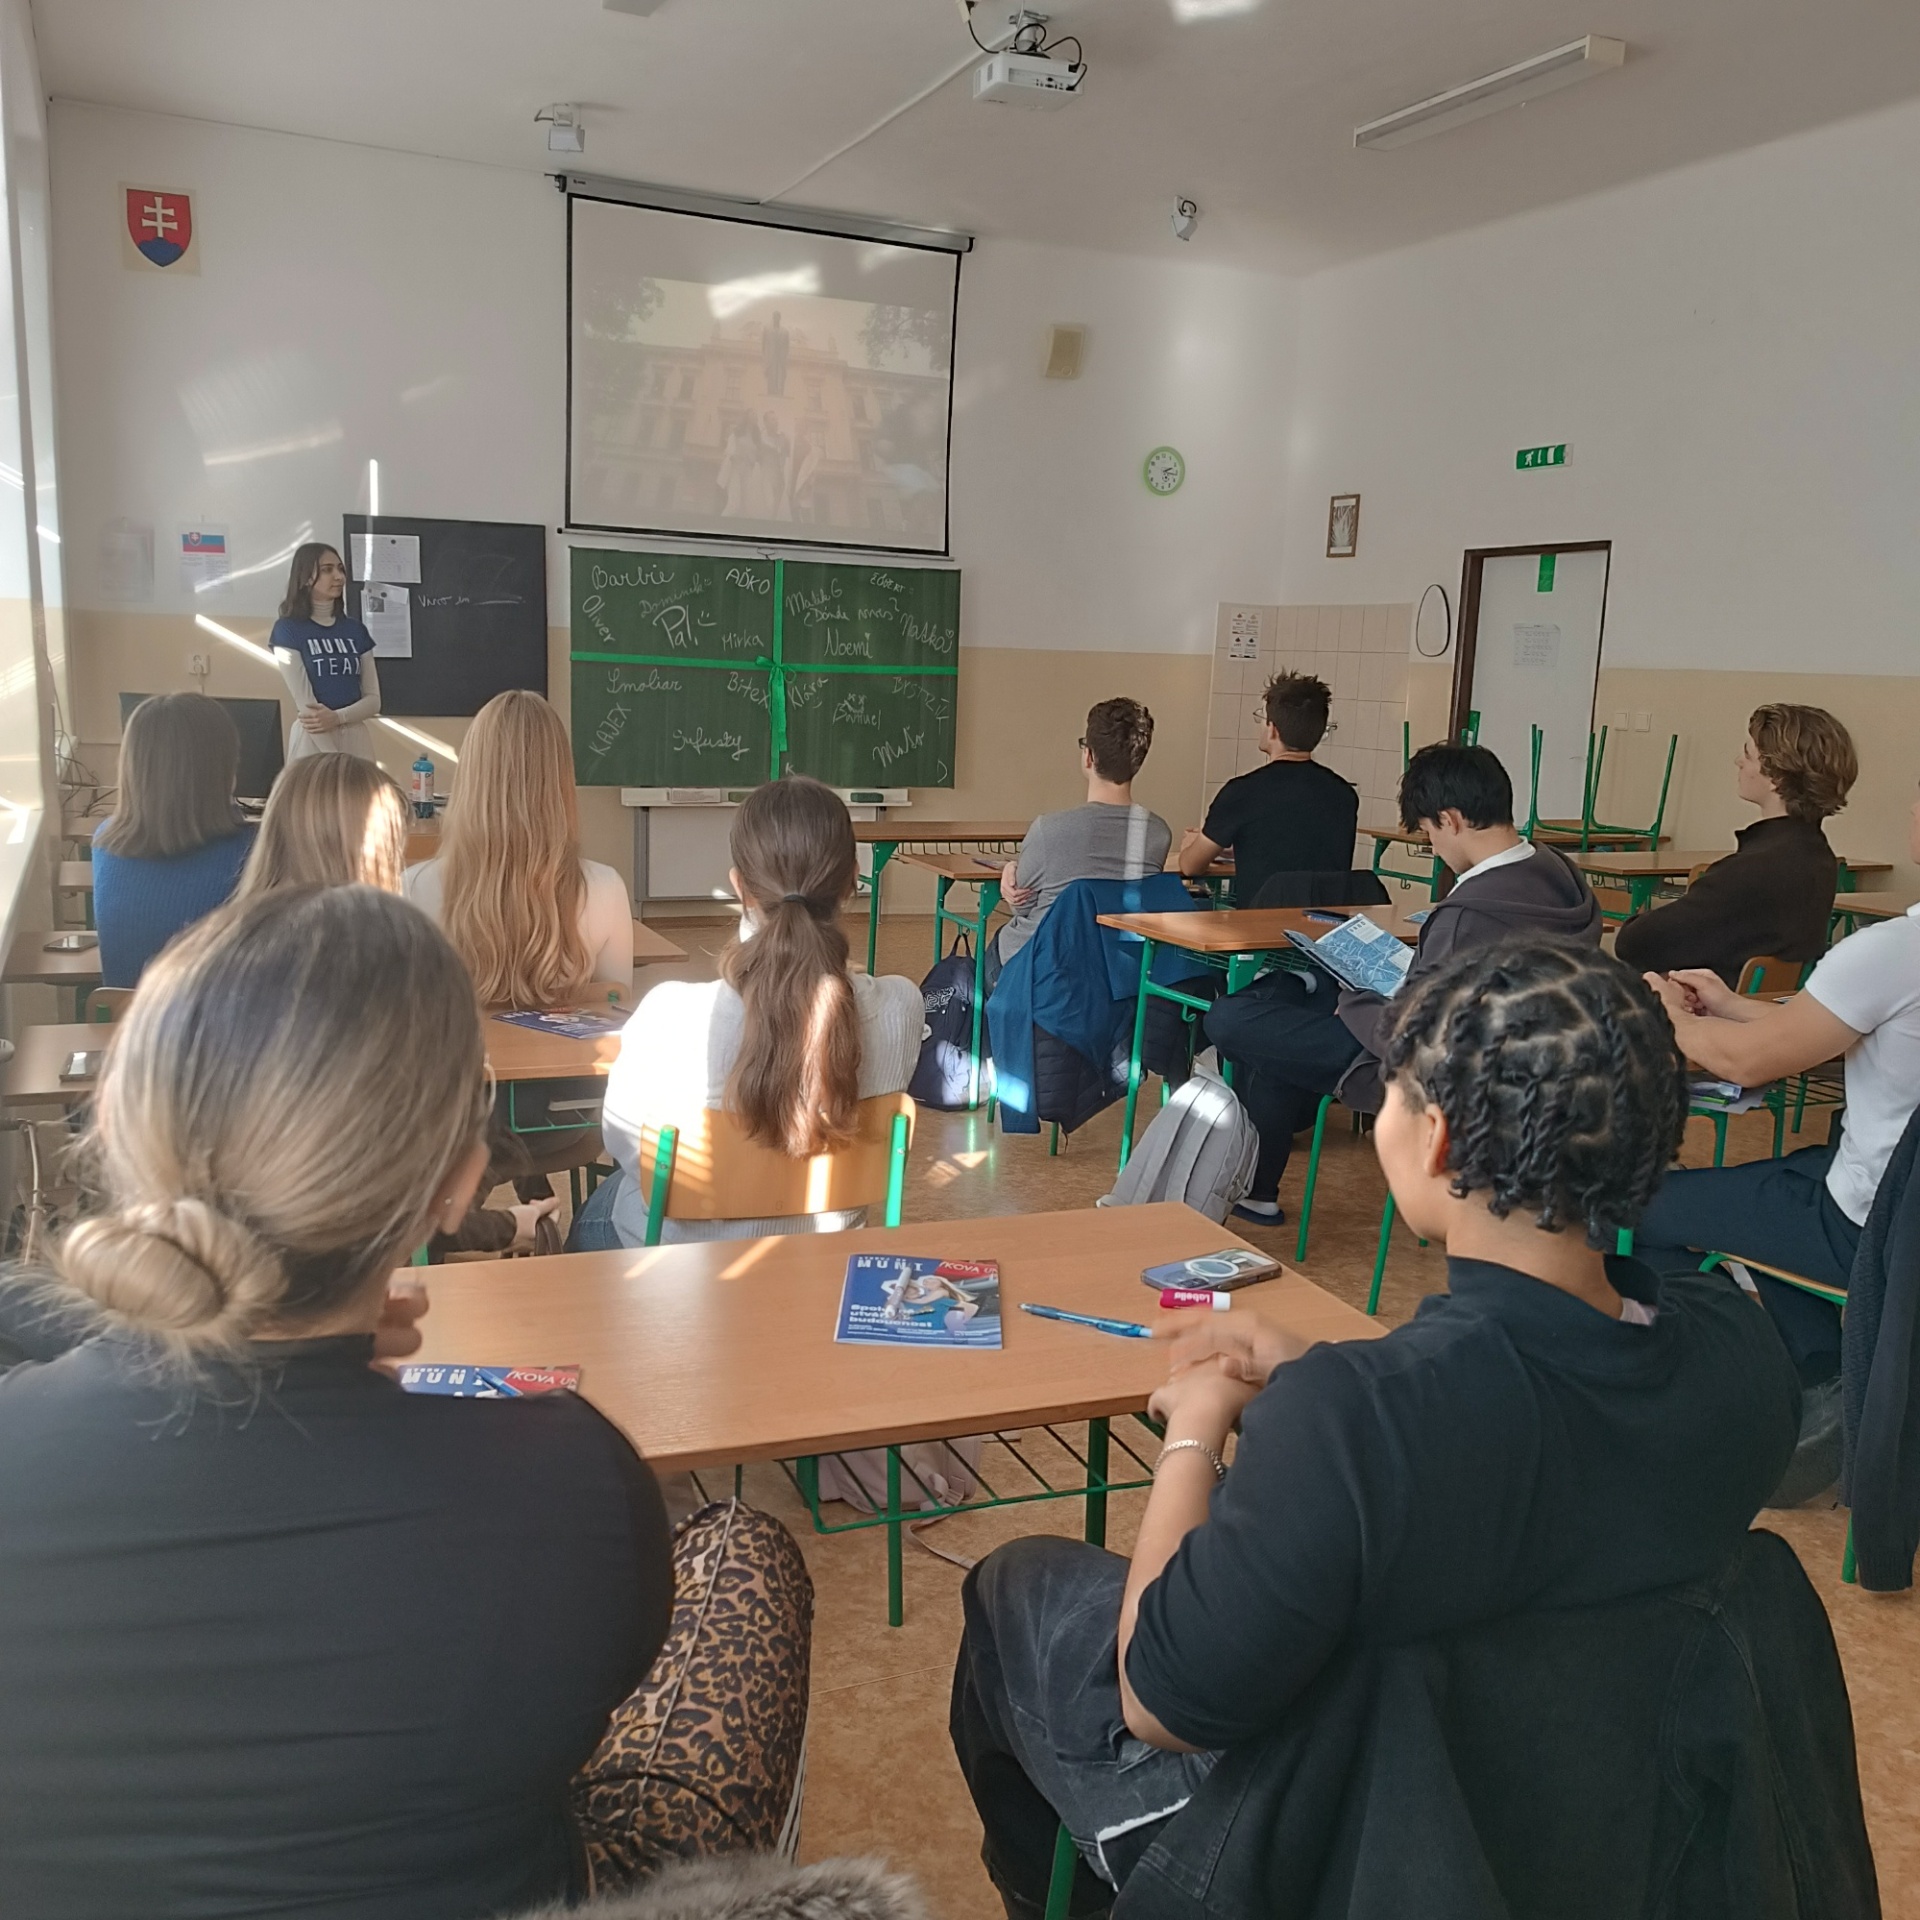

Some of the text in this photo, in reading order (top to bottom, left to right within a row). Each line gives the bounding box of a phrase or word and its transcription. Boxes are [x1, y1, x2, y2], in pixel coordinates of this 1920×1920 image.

[592, 565, 674, 590] Barbie
[582, 595, 616, 642] Oliver
[307, 638, 358, 655] MUNI
[722, 629, 764, 651] Mirka
[824, 627, 874, 659] Noemi
[857, 1259, 923, 1271] MUNI
[1174, 1292, 1210, 1303] Labello
